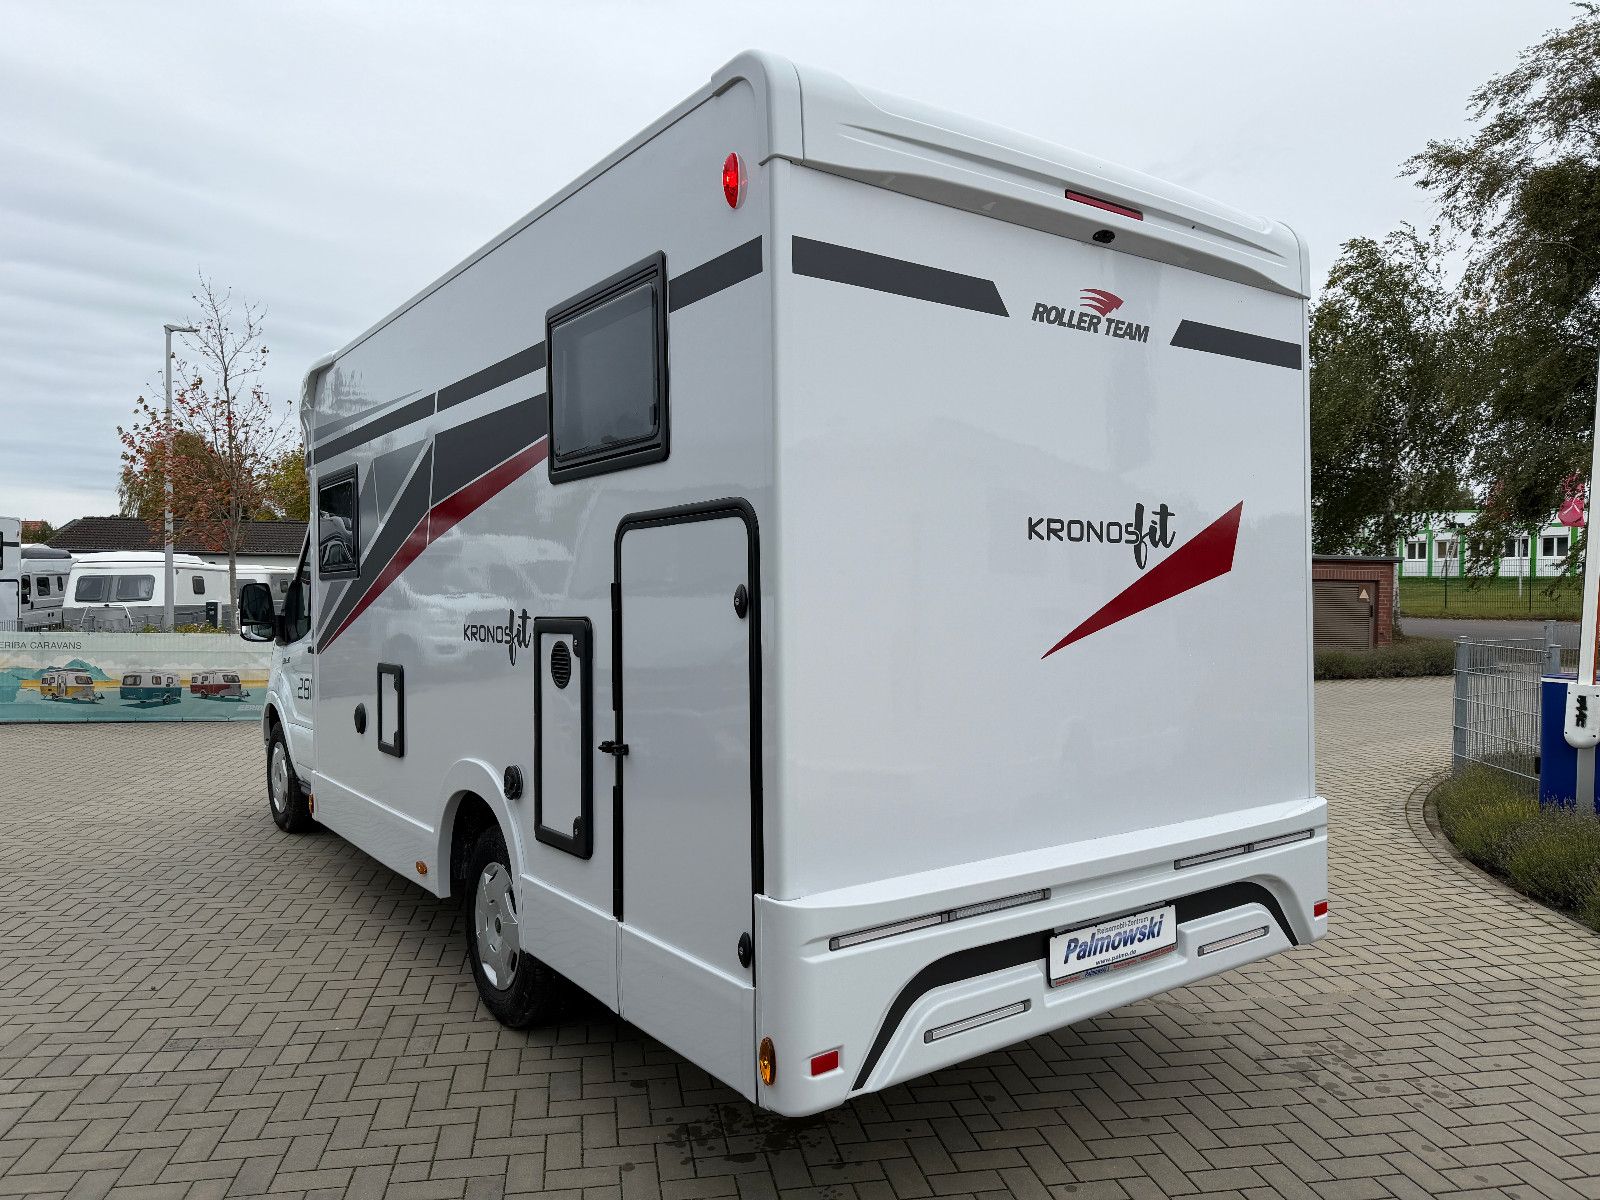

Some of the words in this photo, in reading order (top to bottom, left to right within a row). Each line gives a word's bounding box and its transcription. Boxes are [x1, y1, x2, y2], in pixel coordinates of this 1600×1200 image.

[1031, 302, 1102, 334] ROLLER
[1104, 317, 1150, 343] TEAM
[0, 641, 27, 649] ERIBA
[30, 641, 82, 650] CARAVANS
[1064, 914, 1164, 964] Palmowski
